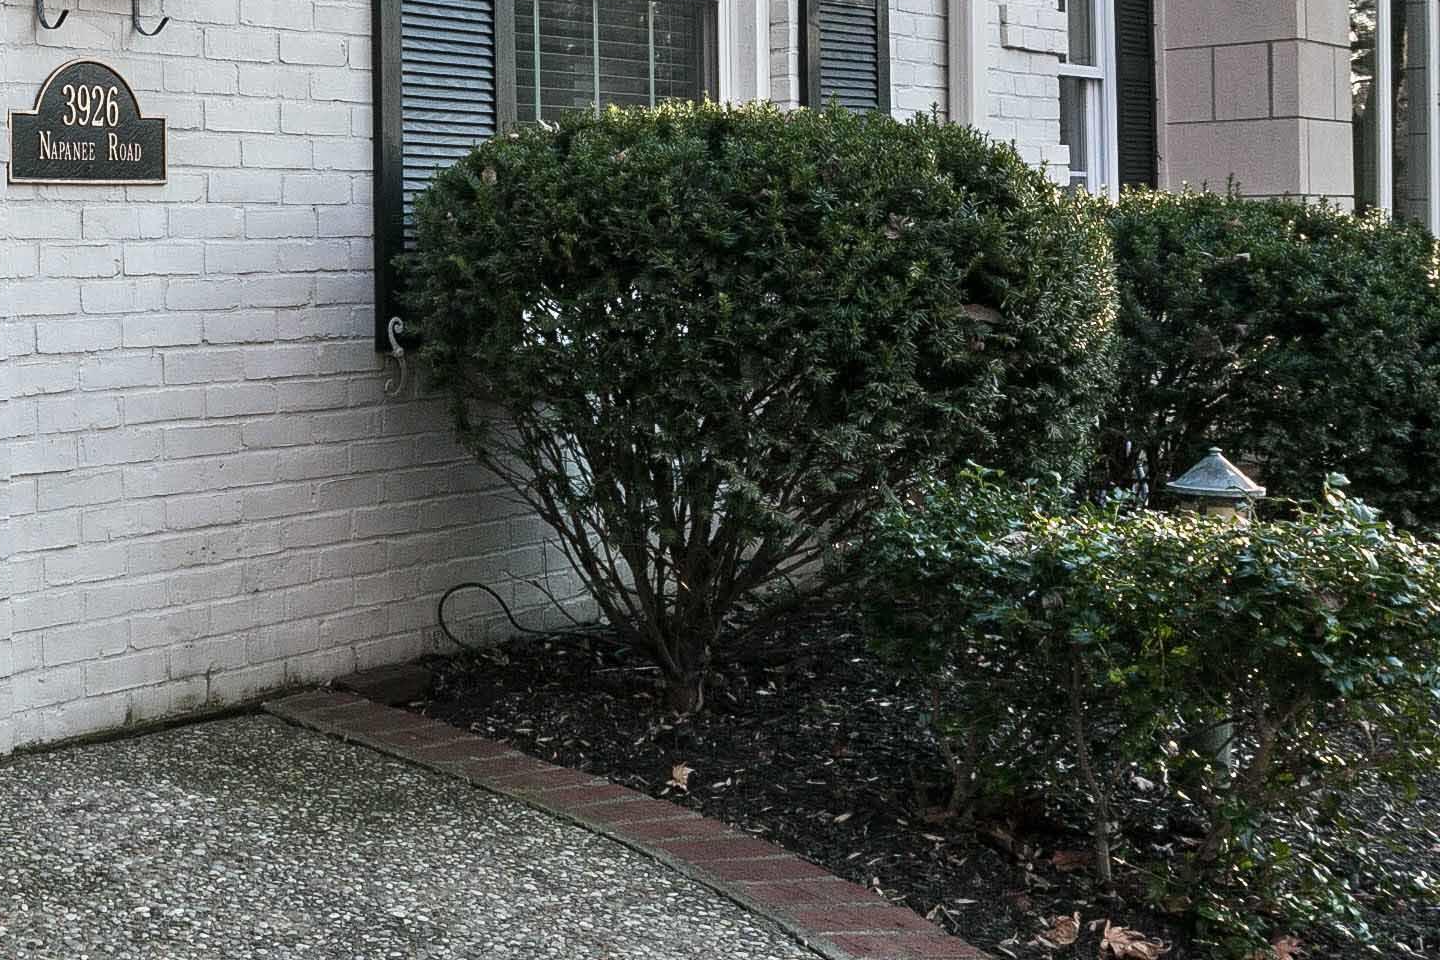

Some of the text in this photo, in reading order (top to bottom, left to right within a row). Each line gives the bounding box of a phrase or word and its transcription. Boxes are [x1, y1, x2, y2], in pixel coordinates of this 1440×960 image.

[62, 84, 119, 127] 3926
[38, 130, 142, 162] NAPANEE ROAD
